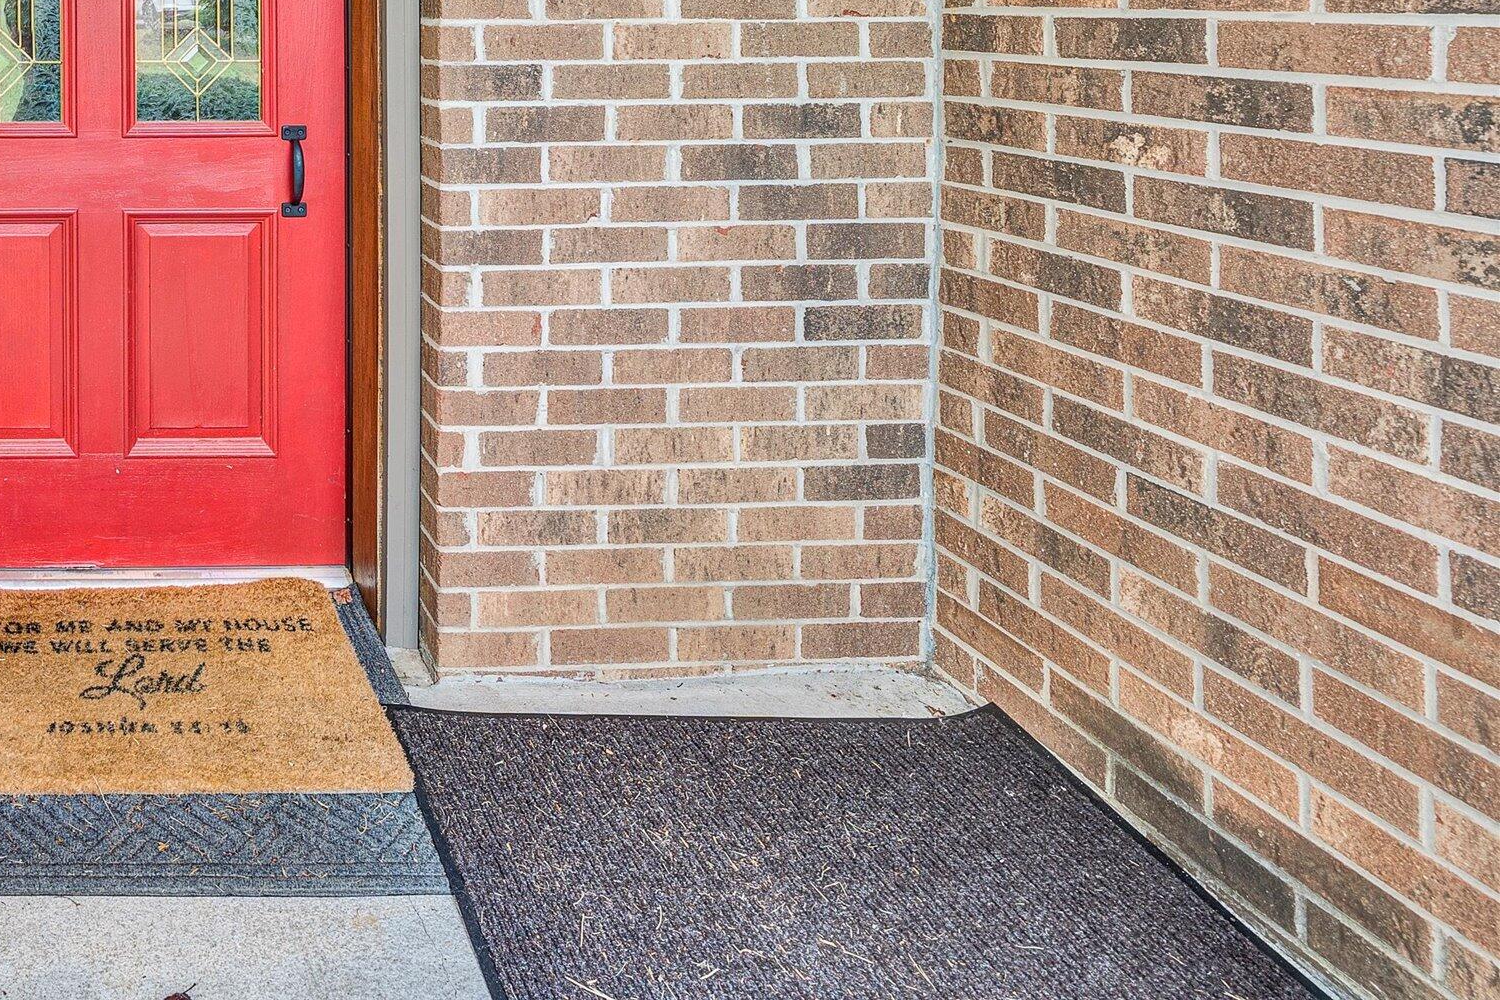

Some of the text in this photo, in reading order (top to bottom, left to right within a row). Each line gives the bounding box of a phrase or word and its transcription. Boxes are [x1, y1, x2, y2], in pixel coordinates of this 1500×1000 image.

[55, 620, 92, 634] ME
[105, 619, 164, 634] AND
[174, 618, 214, 633] MY
[223, 616, 314, 632] HOUSE
[50, 640, 113, 654] WILL
[125, 637, 208, 653] SERVE
[219, 636, 271, 653] THE
[79, 653, 208, 710] Lord
[47, 716, 158, 735] JOSHUA
